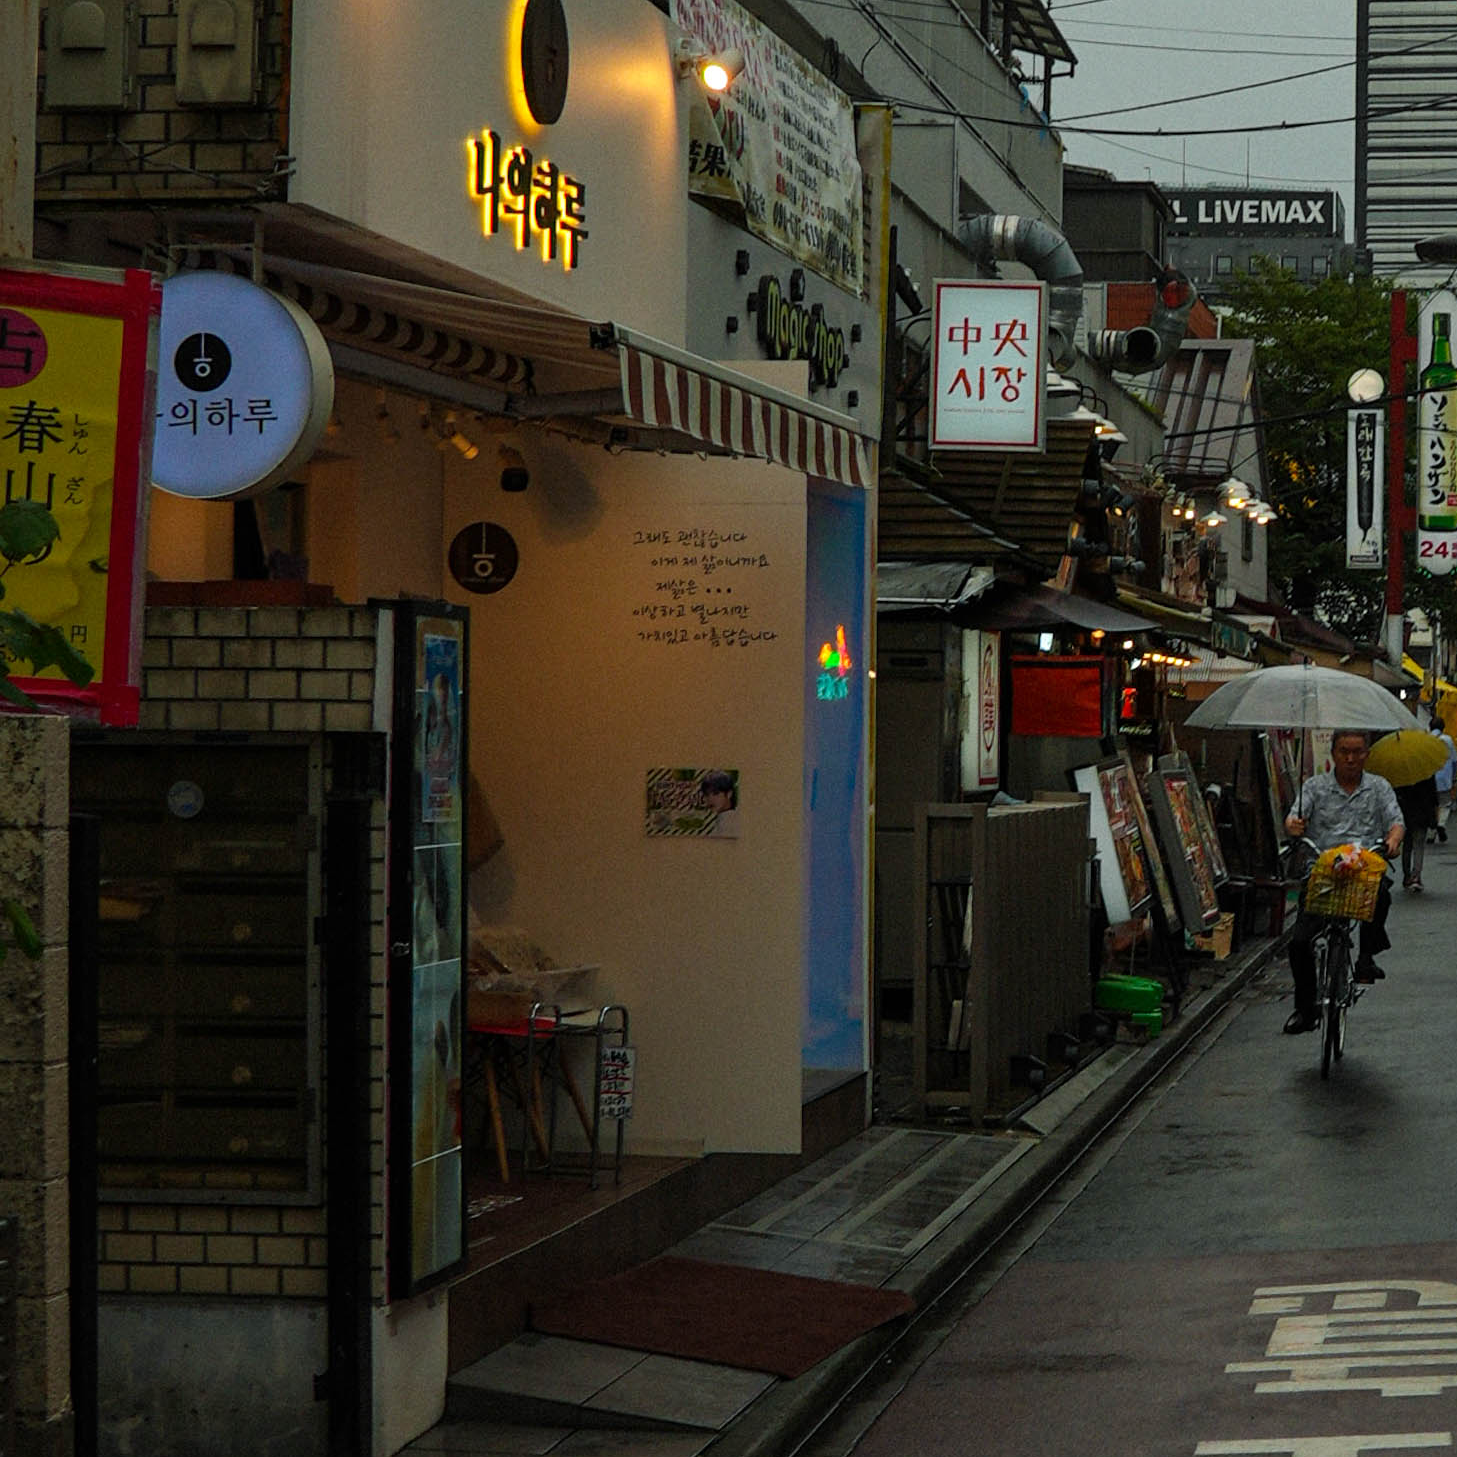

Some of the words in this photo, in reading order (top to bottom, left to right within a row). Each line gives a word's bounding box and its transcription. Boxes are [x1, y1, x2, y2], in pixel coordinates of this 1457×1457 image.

[948, 316, 1030, 357] 中央
[948, 366, 1028, 403] 시장
[68, 412, 89, 456] しゅん
[155, 397, 279, 437] 의하루
[1420, 541, 1449, 558] 24
